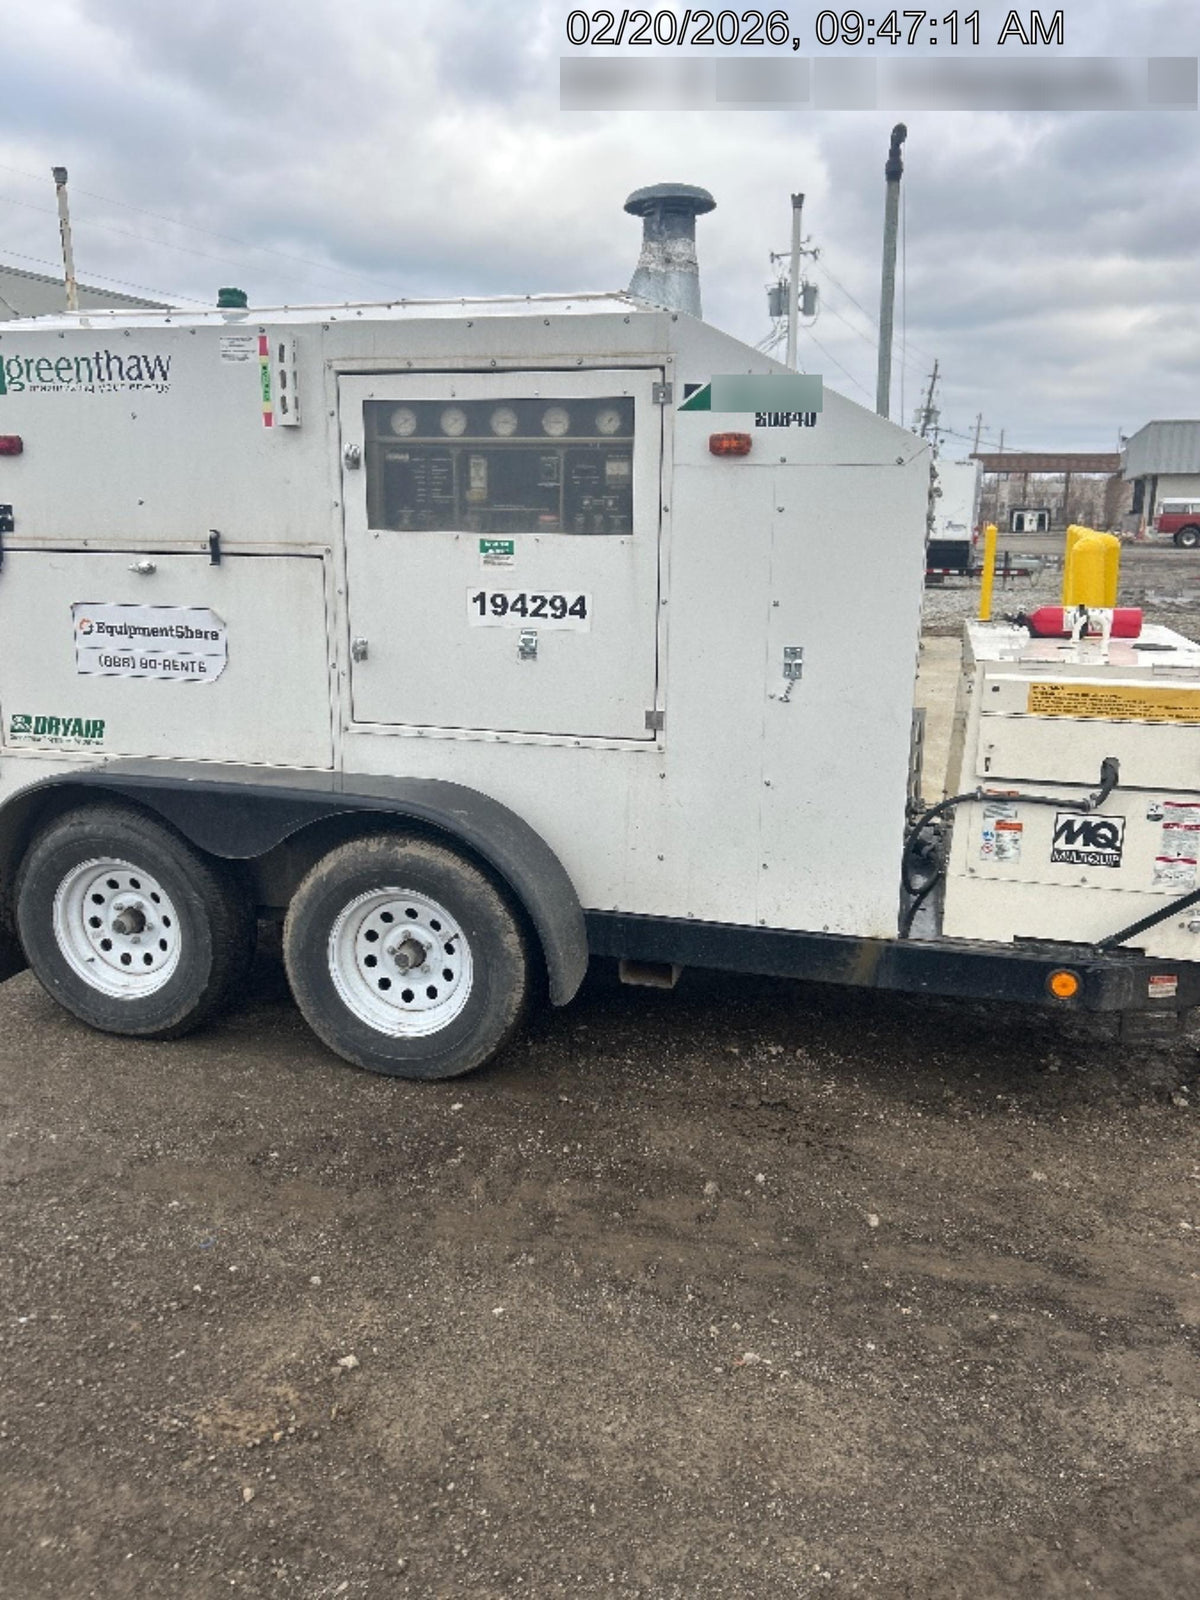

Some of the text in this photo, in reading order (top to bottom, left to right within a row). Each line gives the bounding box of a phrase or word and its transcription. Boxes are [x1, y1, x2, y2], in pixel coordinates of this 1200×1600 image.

[5, 350, 171, 392] greenthaw
[472, 591, 588, 620] 194294
[95, 621, 220, 641] EquipmentShare
[33, 715, 105, 738] DRYAIR
[1053, 818, 1121, 852] MQ
